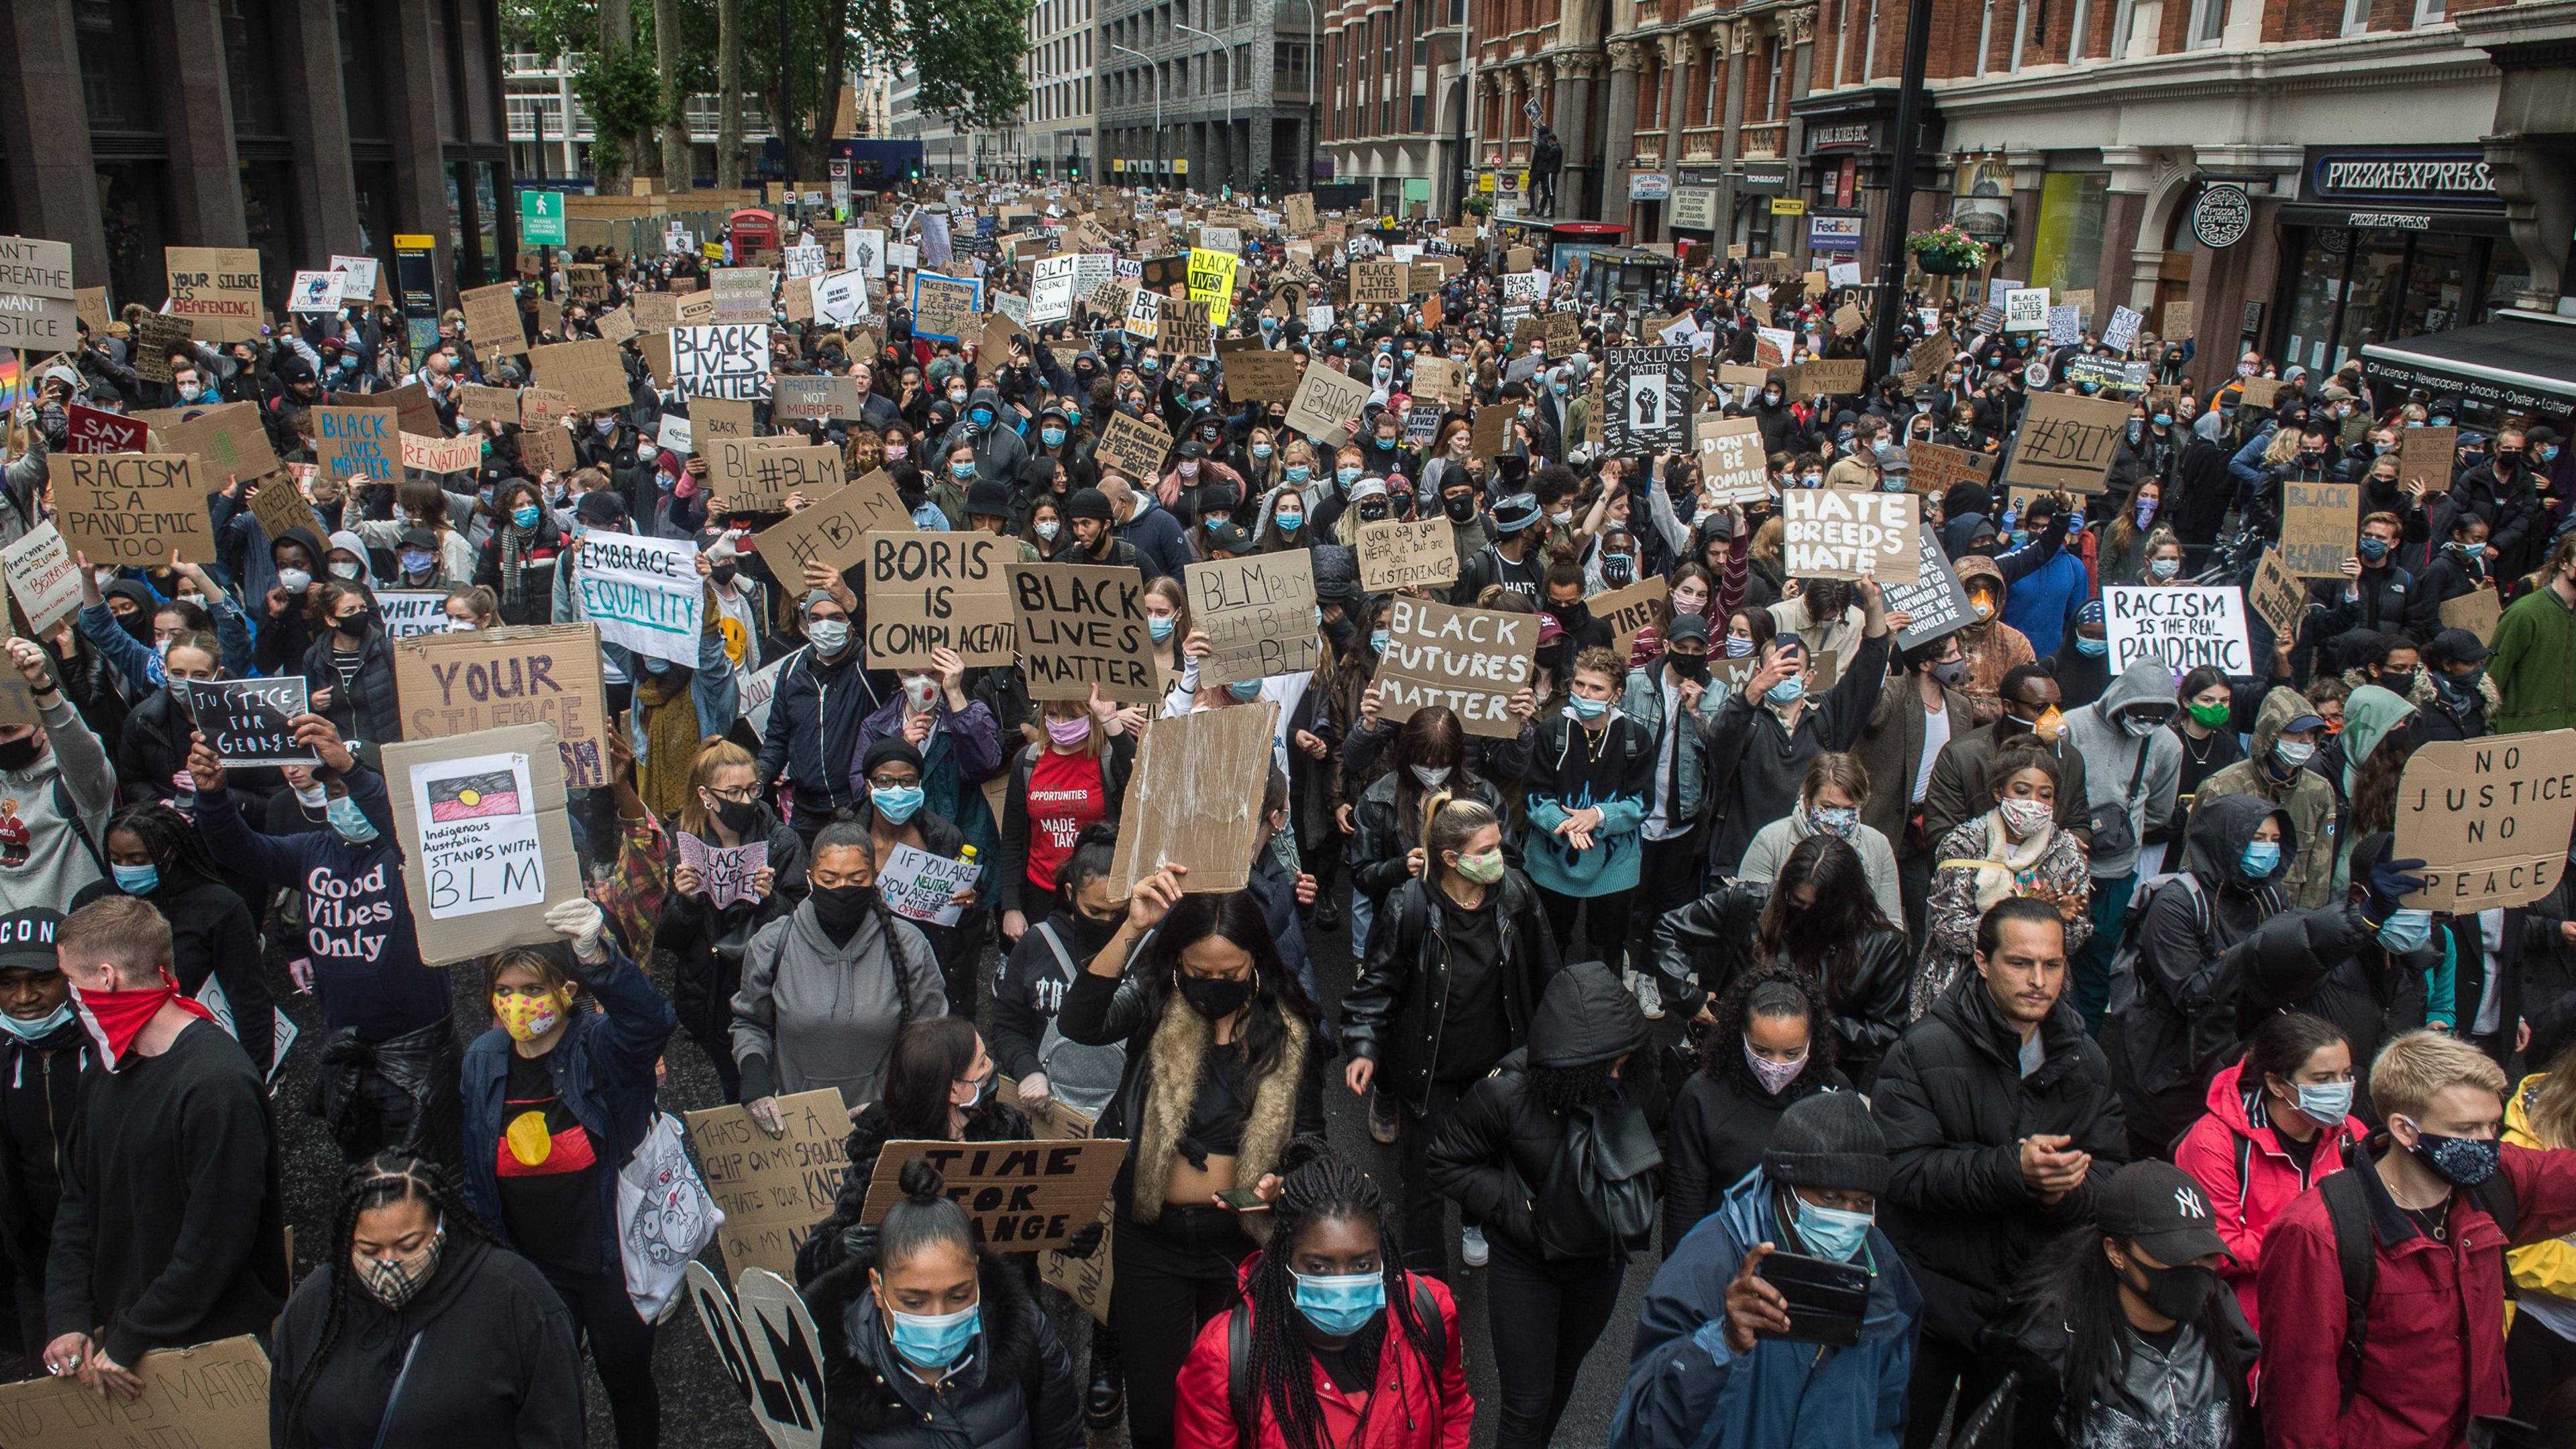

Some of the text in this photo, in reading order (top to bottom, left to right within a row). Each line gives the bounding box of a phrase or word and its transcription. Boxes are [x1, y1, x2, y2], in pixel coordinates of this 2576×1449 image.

[1819, 129, 1834, 144] MAIL
[1835, 127, 1854, 142] BOXES
[1684, 173, 1698, 183] SHOE
[1747, 176, 1784, 184] TONI&GUY
[2200, 215, 2244, 223] EXPRESS
[2208, 207, 2237, 215] PIZZA
[1815, 220, 1853, 232] FedEx
[786, 248, 824, 262] BLACK
[1193, 253, 1232, 274] BLACK
[353, 264, 365, 272] AM
[788, 261, 826, 278] LIVES
[1036, 256, 1072, 278] BLM
[1359, 264, 1396, 277] BLACK
[172, 273, 259, 290] YOUR SILENCE
[344, 284, 371, 294] NEXT?
[920, 279, 975, 296] POLICE BRUTALITY
[1036, 280, 1066, 290] SILENCE
[1097, 282, 1131, 299] BLACK
[1191, 273, 1222, 292] LIVES
[1360, 276, 1396, 288] LIVES
[1507, 274, 1535, 286] BLACK
[1509, 284, 1530, 293] LIVES
[172, 287, 194, 300] IS
[826, 293, 850, 304] SUPREMACY
[1035, 293, 1043, 303] IS
[1356, 287, 1400, 300] MATTER
[2011, 294, 2041, 302] BLACK
[173, 301, 256, 315] DEAFENING!
[684, 301, 712, 317] IKEA
[923, 300, 967, 312] ICEBERG
[1161, 302, 1209, 323] BLACK
[2011, 301, 2042, 311] LIVES
[2116, 306, 2141, 326] BLACK
[1168, 322, 1208, 337] LIVES
[2110, 320, 2138, 337] LIVES
[675, 325, 763, 355] BLACK
[1163, 336, 1211, 354] MATTER
[676, 352, 757, 377] LIVES
[1609, 347, 1690, 364] BLACK LIVES
[2076, 354, 2097, 363] ALL
[1629, 362, 1668, 375] MATTER
[1807, 363, 1864, 376] BLACK LIVES
[2074, 363, 2104, 374] MATTER
[676, 371, 772, 400] MATTER
[784, 380, 839, 392] PROTECT
[1812, 379, 1849, 391] MATTER
[2367, 362, 2575, 417] Off Licence Newspapers Snacks Oyster Lottery
[527, 390, 566, 402] SILENCE
[803, 392, 827, 403] NOT
[1301, 376, 1364, 425] BLM
[788, 404, 845, 416] MURDER
[1412, 407, 1441, 417] BLACK
[85, 417, 134, 444] SAY
[322, 411, 388, 439] BLACK
[1410, 416, 1437, 426] LIVES
[341, 440, 382, 458] LIVES
[1704, 431, 1760, 455] DON'T
[2024, 416, 2125, 464] #BLM
[1722, 449, 1745, 470] BE
[1909, 443, 1962, 464] ARE THEIR
[1910, 454, 1941, 470] LIVES
[71, 459, 193, 488] RACISM
[331, 457, 394, 480] MATTER
[757, 457, 838, 494] #BLM
[91, 490, 146, 511] IS A
[2287, 486, 2353, 508] BLACK
[1786, 490, 1910, 530] HATE
[69, 511, 200, 536] PANDEMIC
[105, 537, 165, 557] TOO
[1430, 539, 1445, 550] are
[1785, 520, 1904, 555] BREEDS
[581, 541, 680, 578] EMBRACE
[874, 539, 994, 582] BORIS
[1369, 557, 1454, 586] LISTENING?
[1930, 570, 1946, 584] GO
[1016, 572, 1145, 622] BLACK
[1200, 564, 1275, 612] BLM
[581, 580, 694, 629] EQUALITY
[925, 586, 955, 619] IS
[1892, 588, 1938, 612] FORWARD
[1935, 594, 1954, 610] WE
[2114, 591, 2225, 619] RACISM
[1392, 600, 1520, 645] BLACK
[1907, 606, 1960, 636] SHOULD BE
[2135, 618, 2223, 636] IS THE REAL
[1029, 615, 1142, 655] LIVES
[1380, 639, 1528, 684] FUTURES
[2118, 637, 2243, 672] PANDEMIC
[431, 654, 563, 706] YOUR
[1030, 654, 1149, 688] MATTER
[195, 686, 293, 710] JUSTICE
[1379, 678, 1509, 722] MATTER
[229, 715, 265, 731] FOR
[217, 731, 296, 754] GEORGE
[2475, 747, 2520, 774] NO
[1030, 789, 1087, 801] OPPORTUNITIES
[2412, 773, 2575, 812] JUSTICE
[425, 822, 490, 843] Indigenous
[1040, 818, 1077, 833] MADE
[2469, 816, 2516, 843] NO
[423, 836, 482, 853] Australia
[432, 838, 537, 869] STANDS WITH
[900, 849, 977, 882] IF YOU ARE
[308, 863, 386, 898] Good
[431, 857, 541, 910] BLM
[881, 875, 909, 896] YOU
[2423, 861, 2547, 896] PEACE
[307, 893, 394, 928] Vibes
[309, 927, 387, 963] Only
[696, 1119, 751, 1148] THATS
[706, 1144, 796, 1181] CHIP MY
[925, 1146, 1083, 1177] TIME
[716, 1186, 804, 1215] THATS YOUR
[2174, 1187, 2206, 1218] NY
[759, 1228, 783, 1252] MY
[700, 1287, 824, 1432] BLM
[155, 1359, 270, 1413] MATTER
